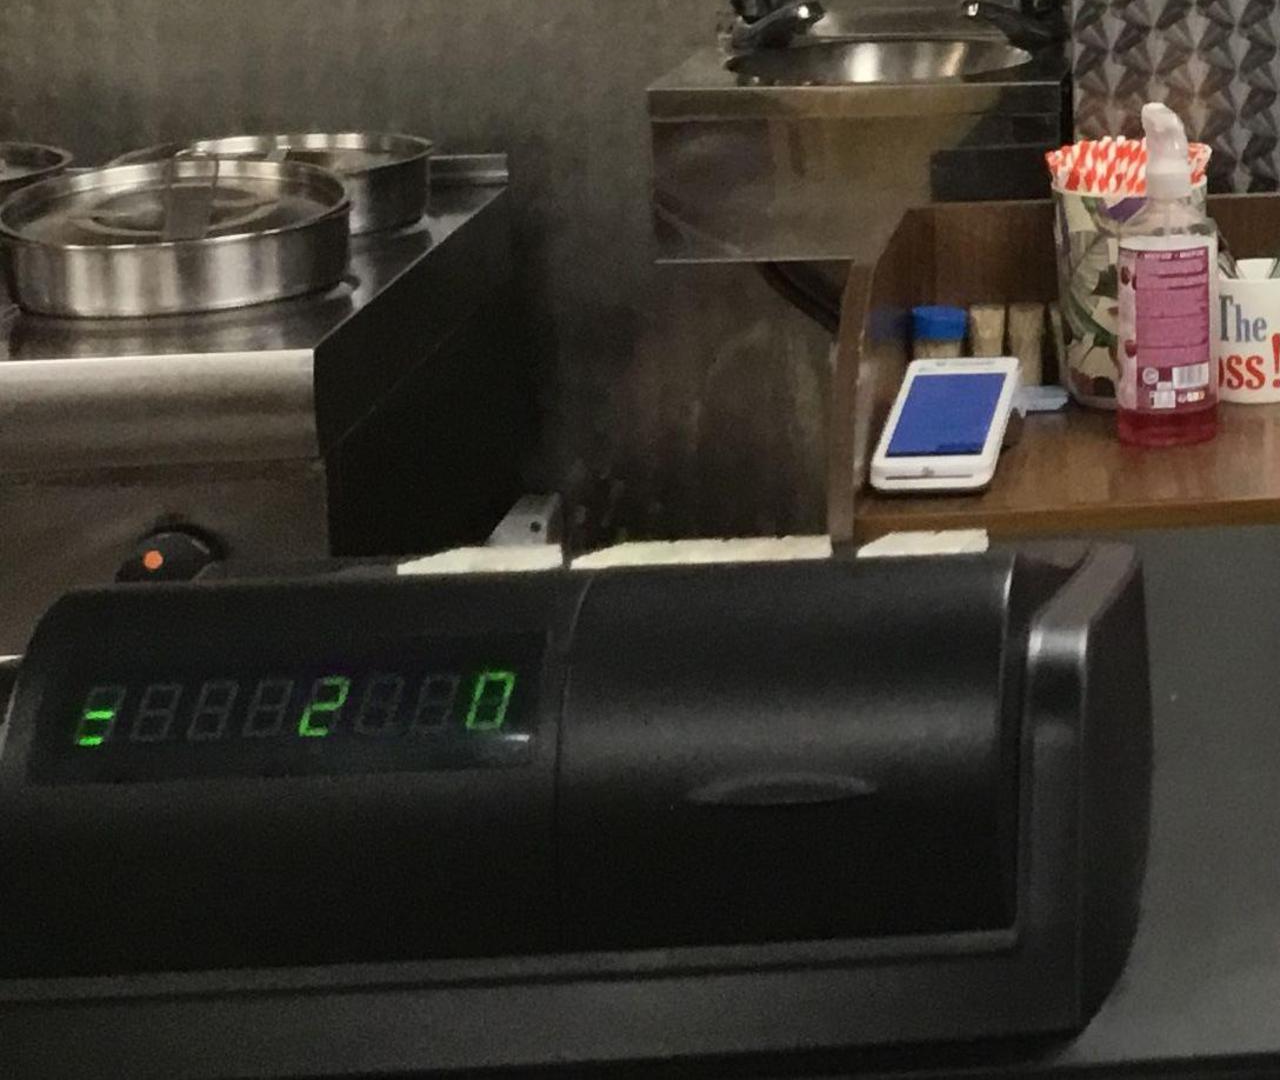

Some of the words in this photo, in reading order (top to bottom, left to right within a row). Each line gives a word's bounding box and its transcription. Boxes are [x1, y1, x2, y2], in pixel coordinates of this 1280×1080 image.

[1218, 294, 1267, 343] The
[298, 676, 352, 738] 2
[465, 671, 517, 731] 0
